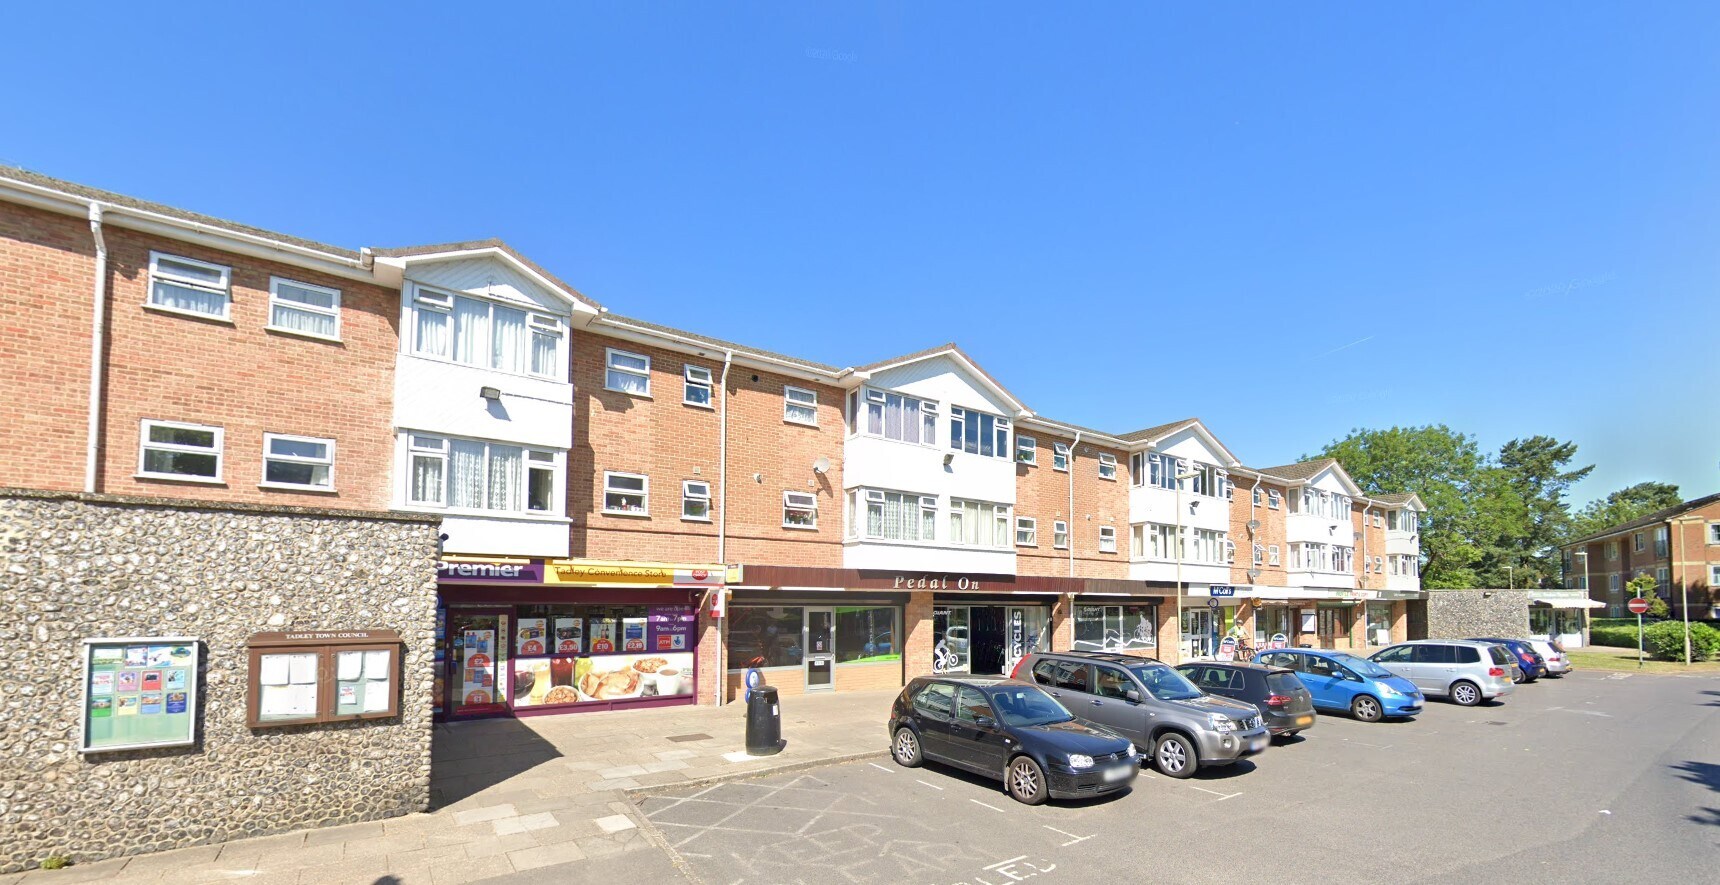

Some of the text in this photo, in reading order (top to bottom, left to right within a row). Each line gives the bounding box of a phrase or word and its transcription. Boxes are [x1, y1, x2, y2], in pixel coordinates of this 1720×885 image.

[437, 561, 524, 578] Premier
[555, 566, 585, 577] Tadley
[587, 568, 642, 577] Convenience
[893, 574, 979, 590] Pedal On
